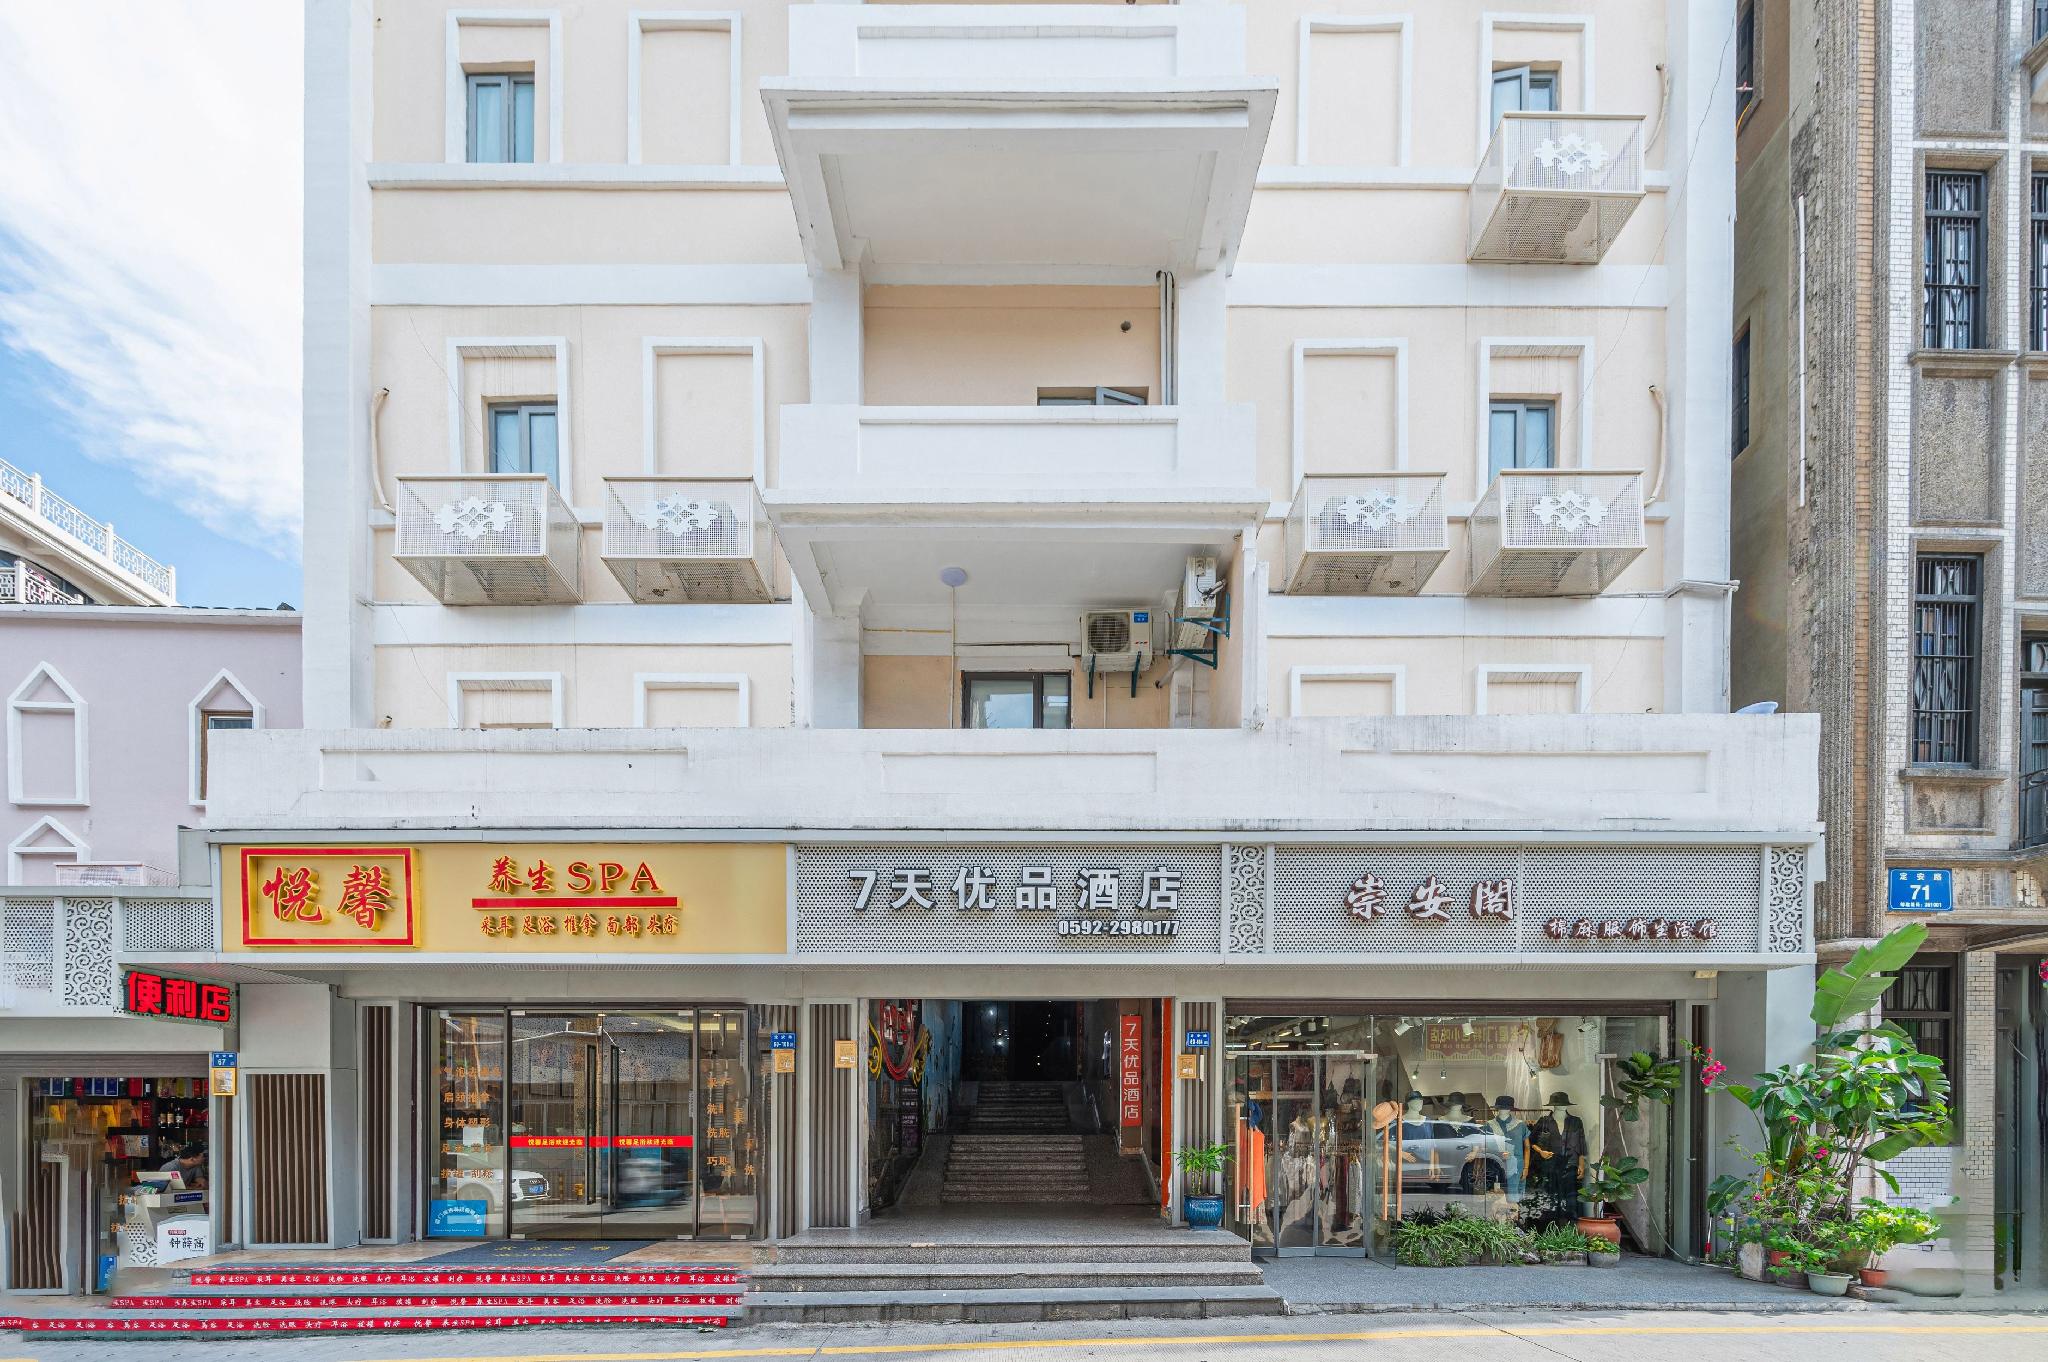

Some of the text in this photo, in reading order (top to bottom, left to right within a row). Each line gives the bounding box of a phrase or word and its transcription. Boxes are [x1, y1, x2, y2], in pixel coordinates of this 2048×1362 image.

[489, 855, 661, 892] 养生SPA
[847, 865, 1182, 911] 7天优品酒店
[1910, 884, 1930, 900] 71
[261, 864, 392, 930] 悦馨
[522, 914, 555, 935] 足浴
[563, 914, 597, 935] 推拿
[606, 914, 639, 935] 面部
[647, 914, 679, 935] 头疗
[1057, 919, 1181, 936] 0592-2980177
[1547, 917, 1720, 939] 棉麻服饰生活馆
[127, 970, 231, 1022] 便利店
[1123, 1022, 1141, 1120] 7天优品酒店
